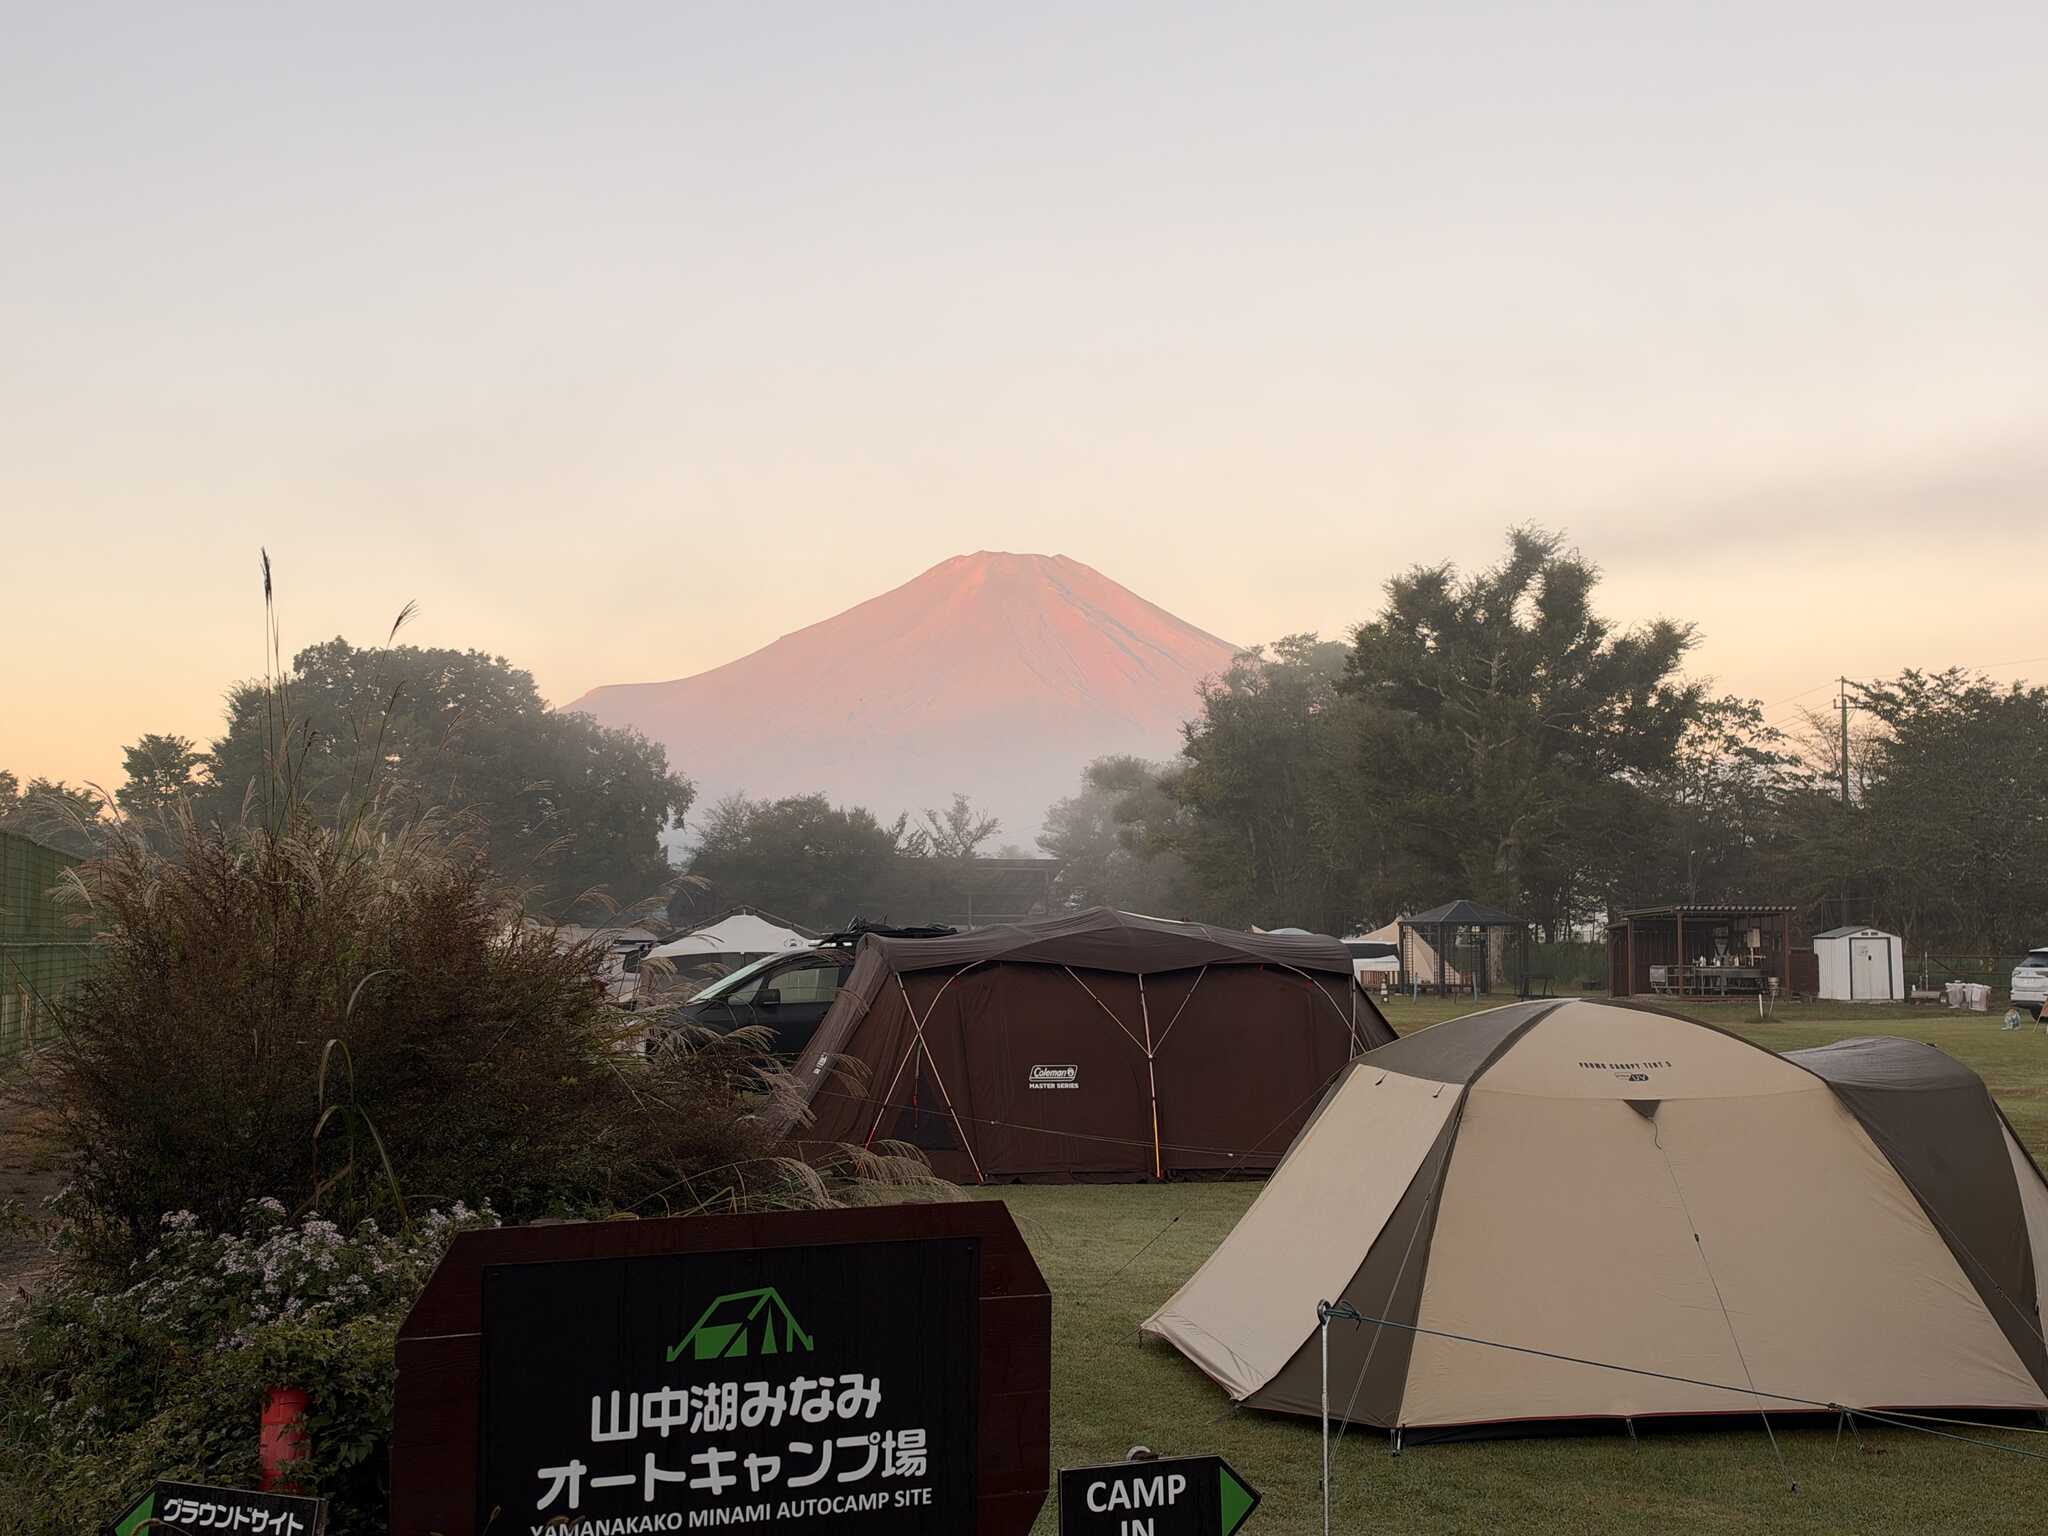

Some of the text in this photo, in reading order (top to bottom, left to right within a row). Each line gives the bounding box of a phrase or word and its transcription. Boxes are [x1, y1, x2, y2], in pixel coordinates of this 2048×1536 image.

[1034, 1067, 1067, 1077] Coleman
[591, 1373, 883, 1442] 山中湖みなみ
[537, 1428, 928, 1511] オートキャンプ場
[689, 1503, 771, 1528] MINAMI
[776, 1492, 890, 1519] AUTOCAMP
[894, 1487, 932, 1508] SITE
[1086, 1474, 1186, 1513] CAMP
[163, 1498, 304, 1536] グラウンドサイト
[1121, 1517, 1155, 1536] IN
